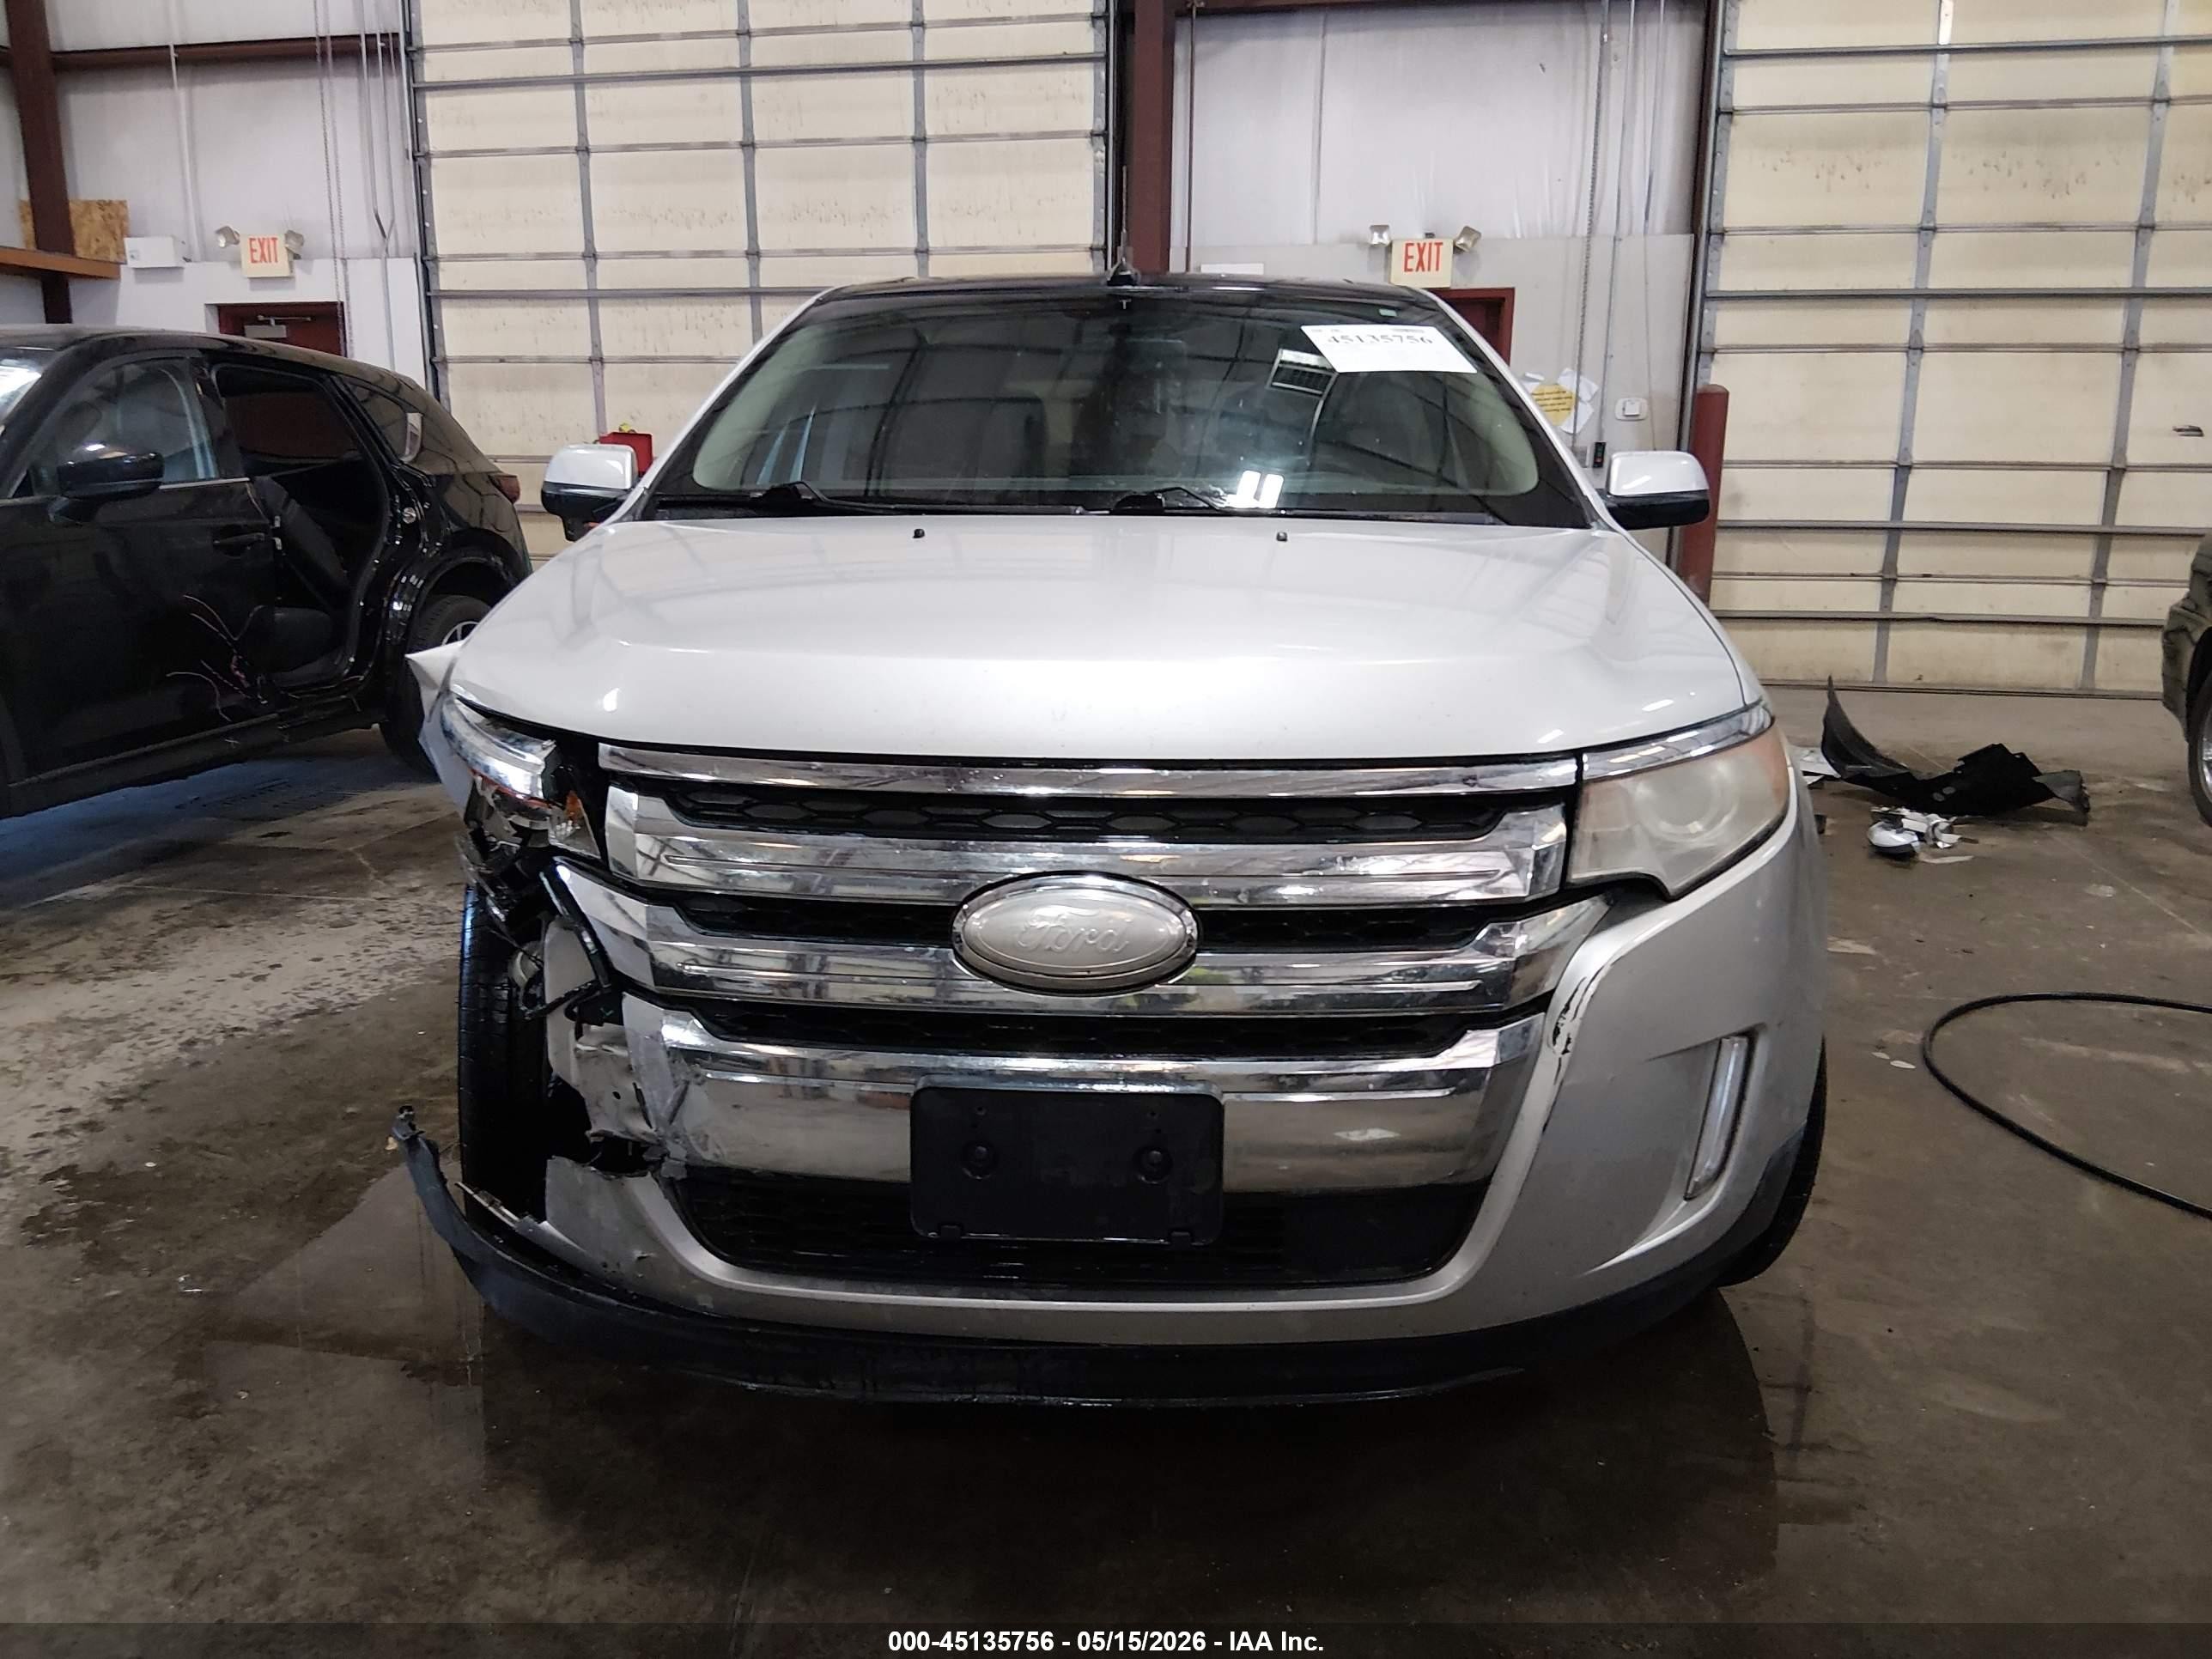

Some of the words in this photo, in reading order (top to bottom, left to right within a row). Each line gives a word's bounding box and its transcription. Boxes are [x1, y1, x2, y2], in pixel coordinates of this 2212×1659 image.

[249, 237, 278, 264] EXIT
[1404, 242, 1443, 272] EXIT
[1328, 335, 1433, 344] 45135756
[1017, 905, 1133, 954] Ford
